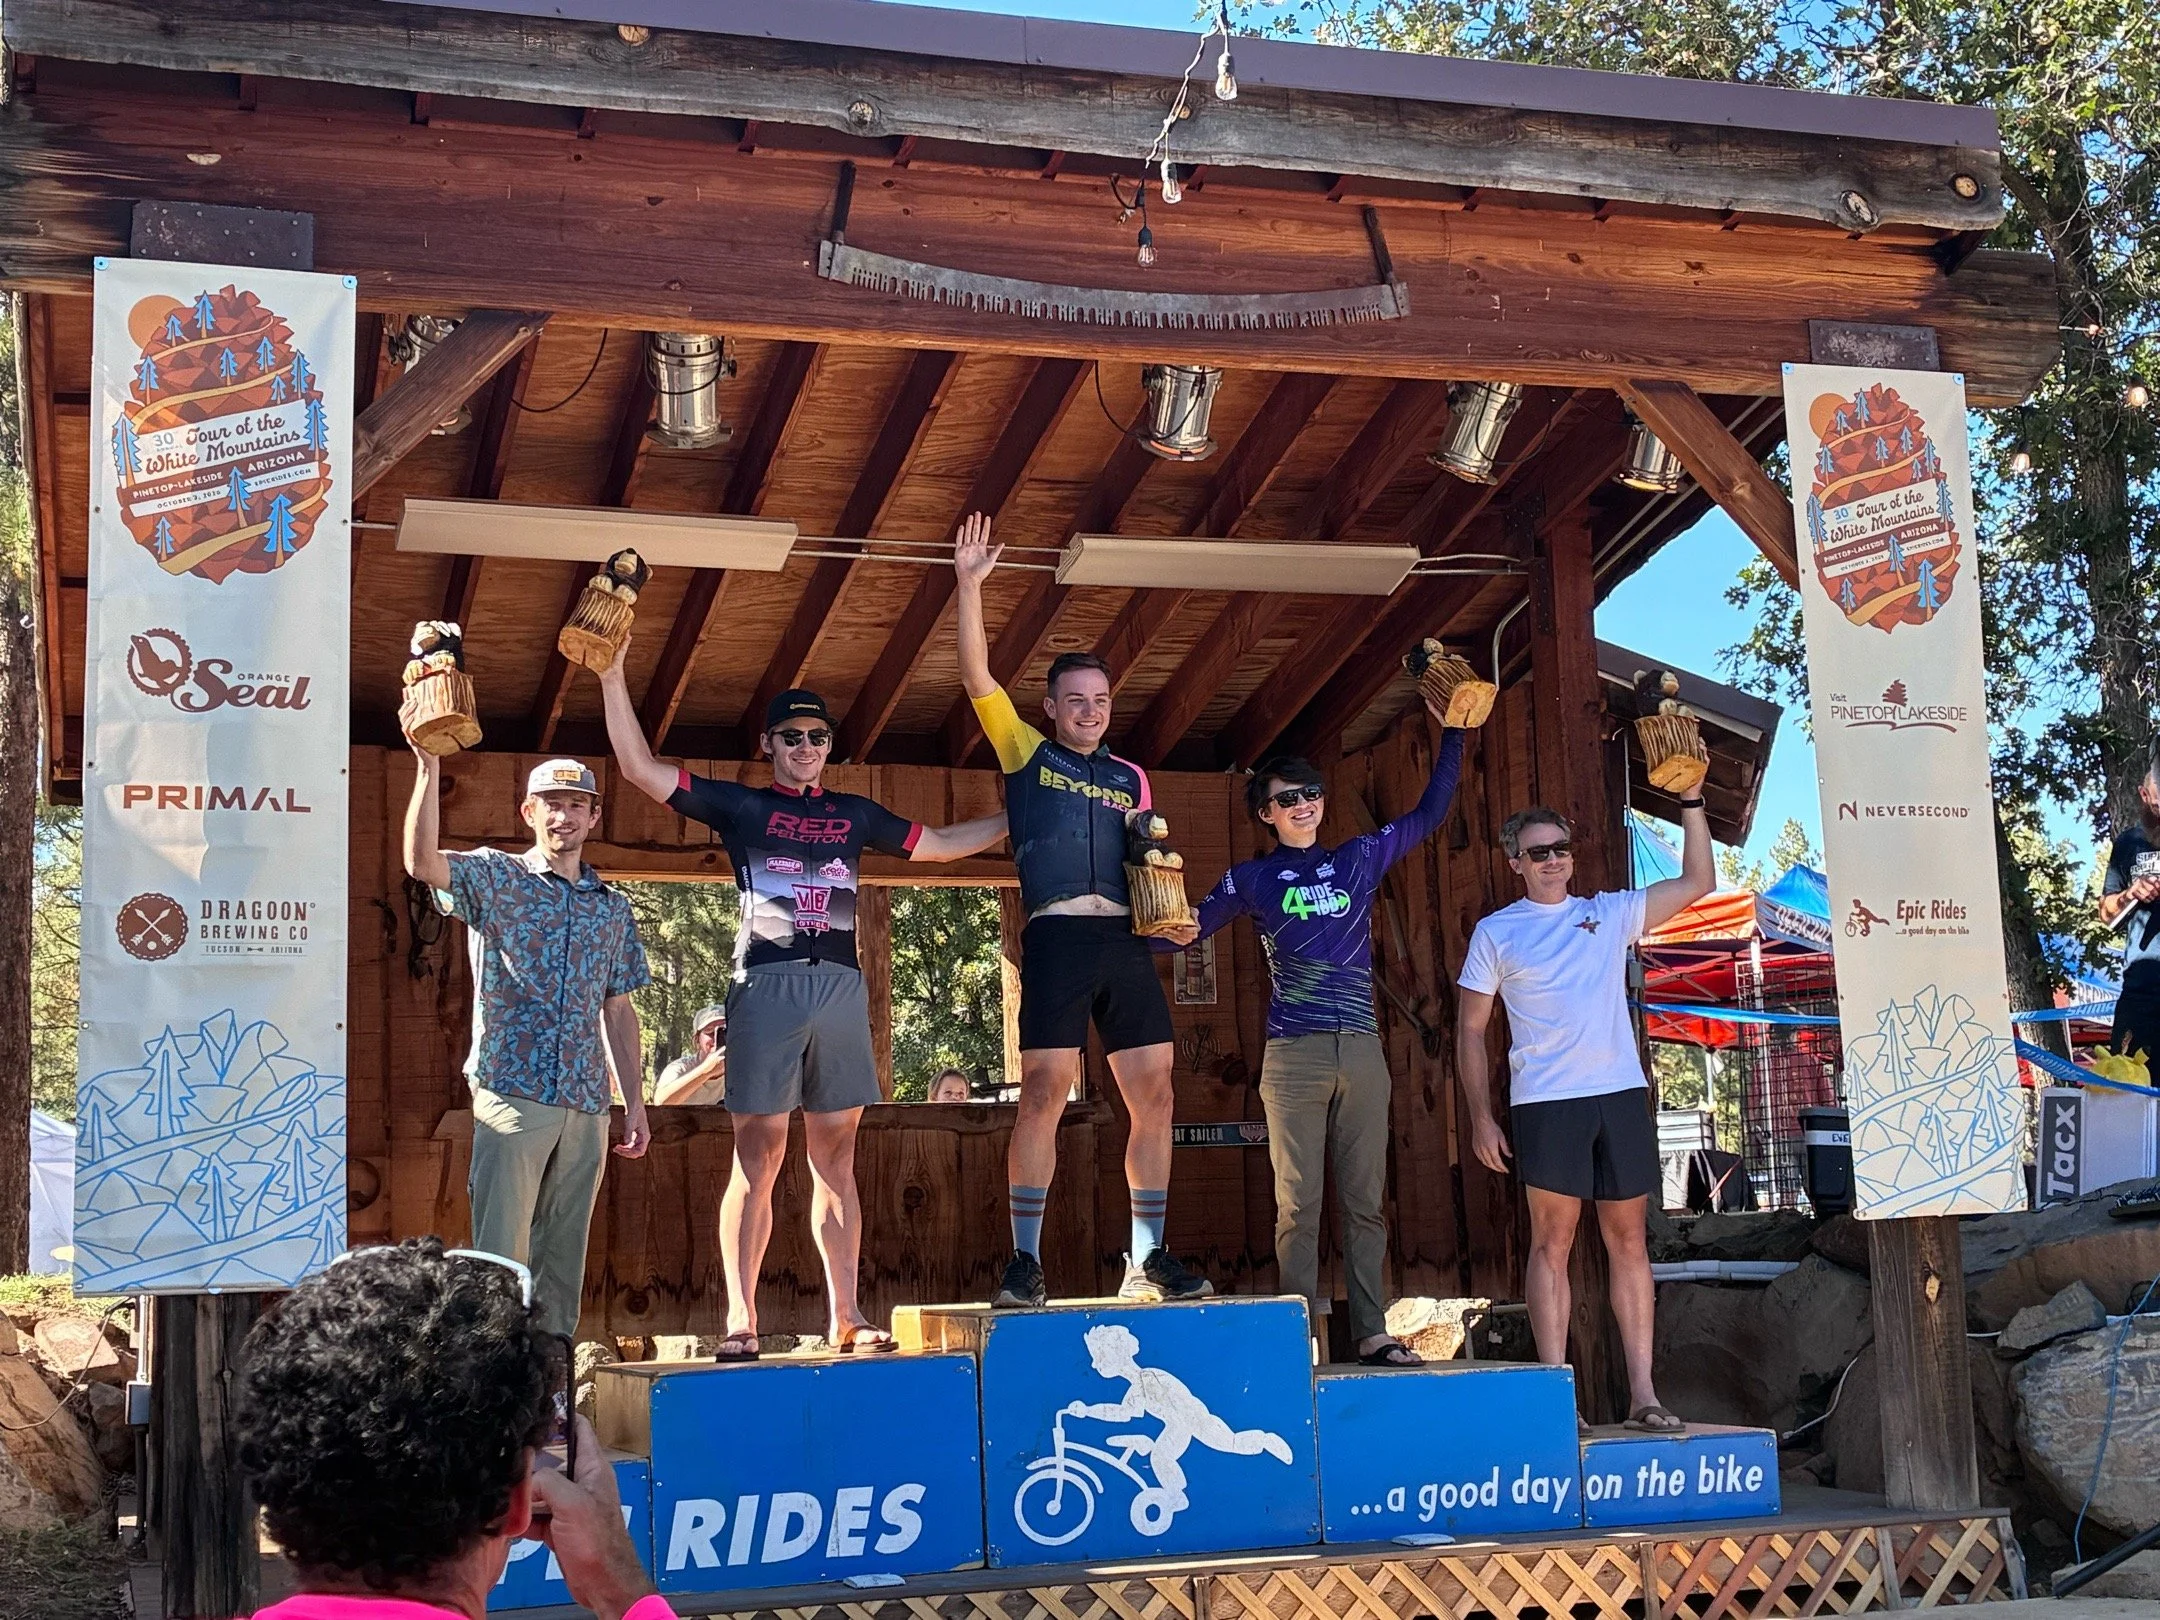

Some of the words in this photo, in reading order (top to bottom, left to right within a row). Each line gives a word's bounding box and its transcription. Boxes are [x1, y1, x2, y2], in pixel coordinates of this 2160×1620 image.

[152, 432, 174, 447] 30
[186, 427, 231, 445] Tour
[236, 416, 253, 435] of
[257, 413, 285, 432] the
[146, 452, 200, 475] White
[206, 431, 301, 462] Mountains
[132, 472, 224, 498] PINETOP-LAKESIDE
[247, 451, 305, 472] ARIZONA
[1834, 507, 1849, 520] 30
[1856, 502, 1887, 518] Tour
[1889, 492, 1902, 509] of
[1904, 490, 1924, 506] the
[1830, 524, 1867, 543] White
[1871, 505, 1935, 532] Mountains
[1900, 523, 1939, 540] ARIZONA
[171, 658, 311, 713] Seal
[237, 673, 291, 682] ORANGE
[123, 785, 312, 812] PRIMAL
[1039, 766, 1134, 808] BEYOND
[769, 812, 851, 834] RED
[1866, 805, 1969, 818] NEVERSECOND
[766, 827, 848, 844] PELOTON
[1299, 882, 1335, 901] RIDE
[200, 900, 308, 921] DRAGOON
[1896, 899, 1926, 925] Epic
[1931, 899, 1966, 919] Rides
[200, 925, 279, 939] BREWING
[289, 926, 308, 940] CO
[205, 945, 241, 953] TUCSON
[2065, 1002, 2116, 1016] SHIMA
[2047, 1103, 2076, 1196] Tacx
[1419, 1466, 1499, 1523] good
[1512, 1464, 1572, 1513] day
[1586, 1474, 1623, 1501] on
[1637, 1459, 1685, 1498] the
[1698, 1454, 1763, 1495] bike
[666, 1483, 927, 1571] RIDES
